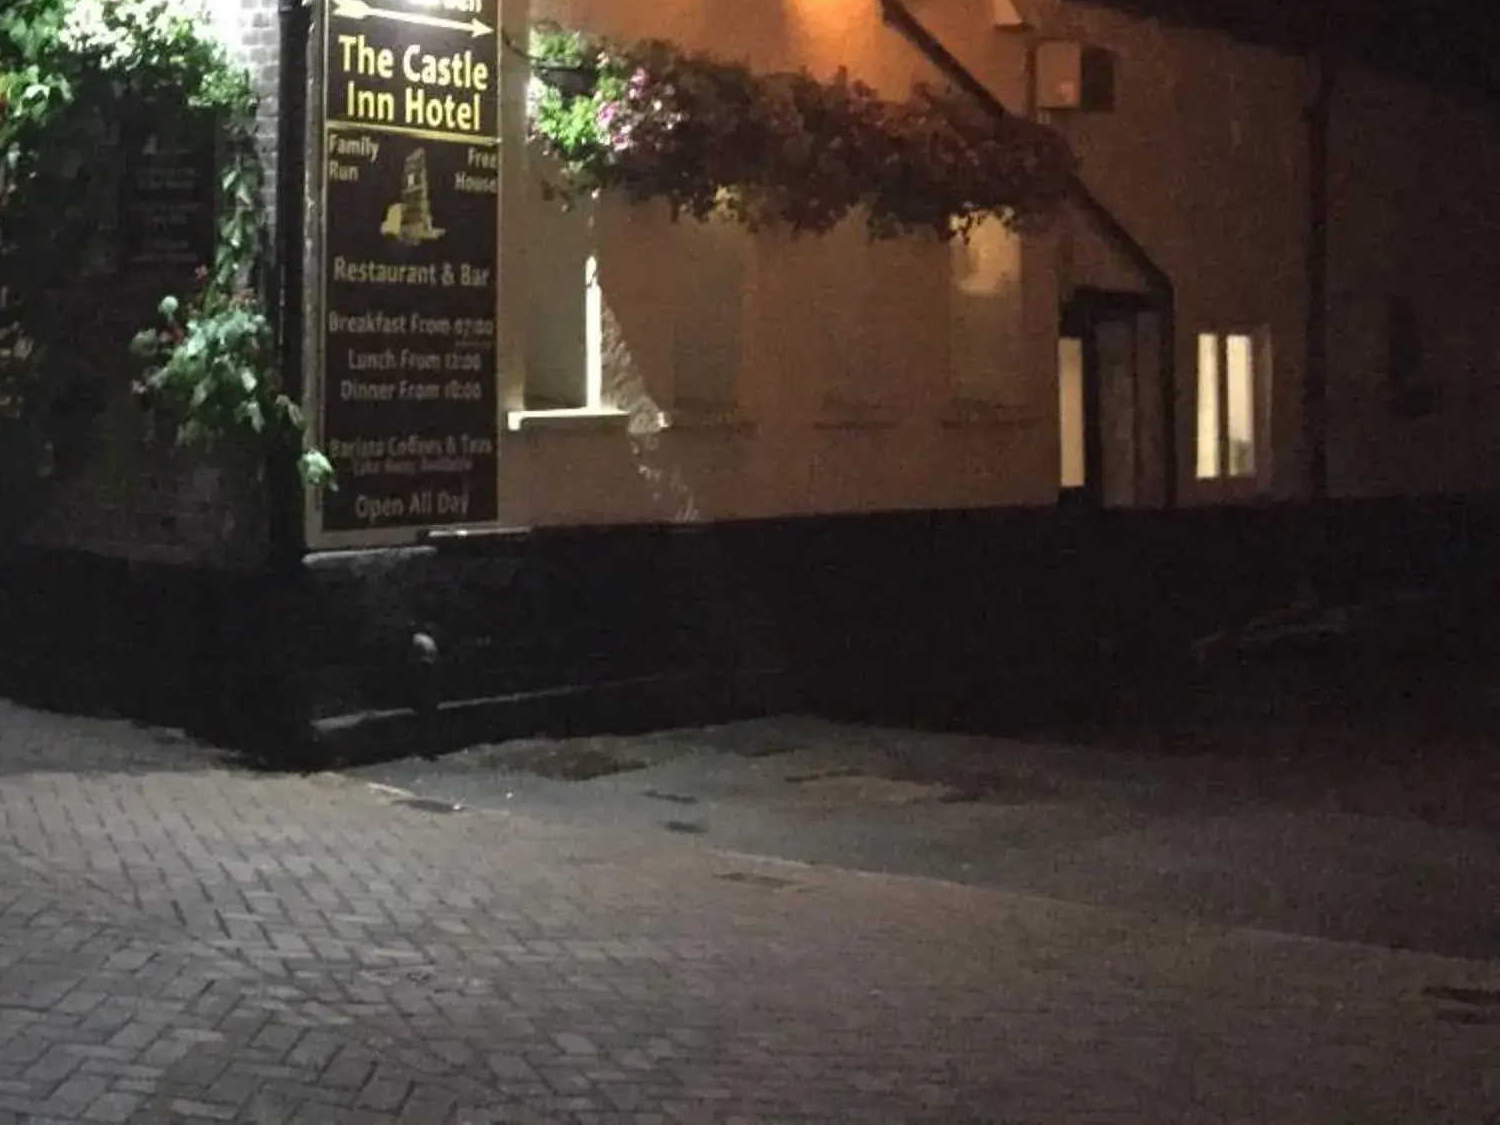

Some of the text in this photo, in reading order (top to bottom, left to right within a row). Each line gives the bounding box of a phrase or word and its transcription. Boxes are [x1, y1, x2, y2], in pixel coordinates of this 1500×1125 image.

[338, 35, 489, 91] The Castle
[347, 81, 481, 132] Inn Hotel
[328, 133, 380, 163] Family
[466, 145, 497, 170] Free
[328, 160, 359, 183] Run
[454, 170, 497, 195] House
[333, 255, 491, 288] Restaurant & Bar
[328, 309, 406, 334] Breakfast
[348, 347, 397, 371] Lunch
[401, 347, 442, 372] From
[340, 377, 396, 402] Dinner
[400, 378, 441, 401] From
[355, 487, 470, 523] Open All Day
